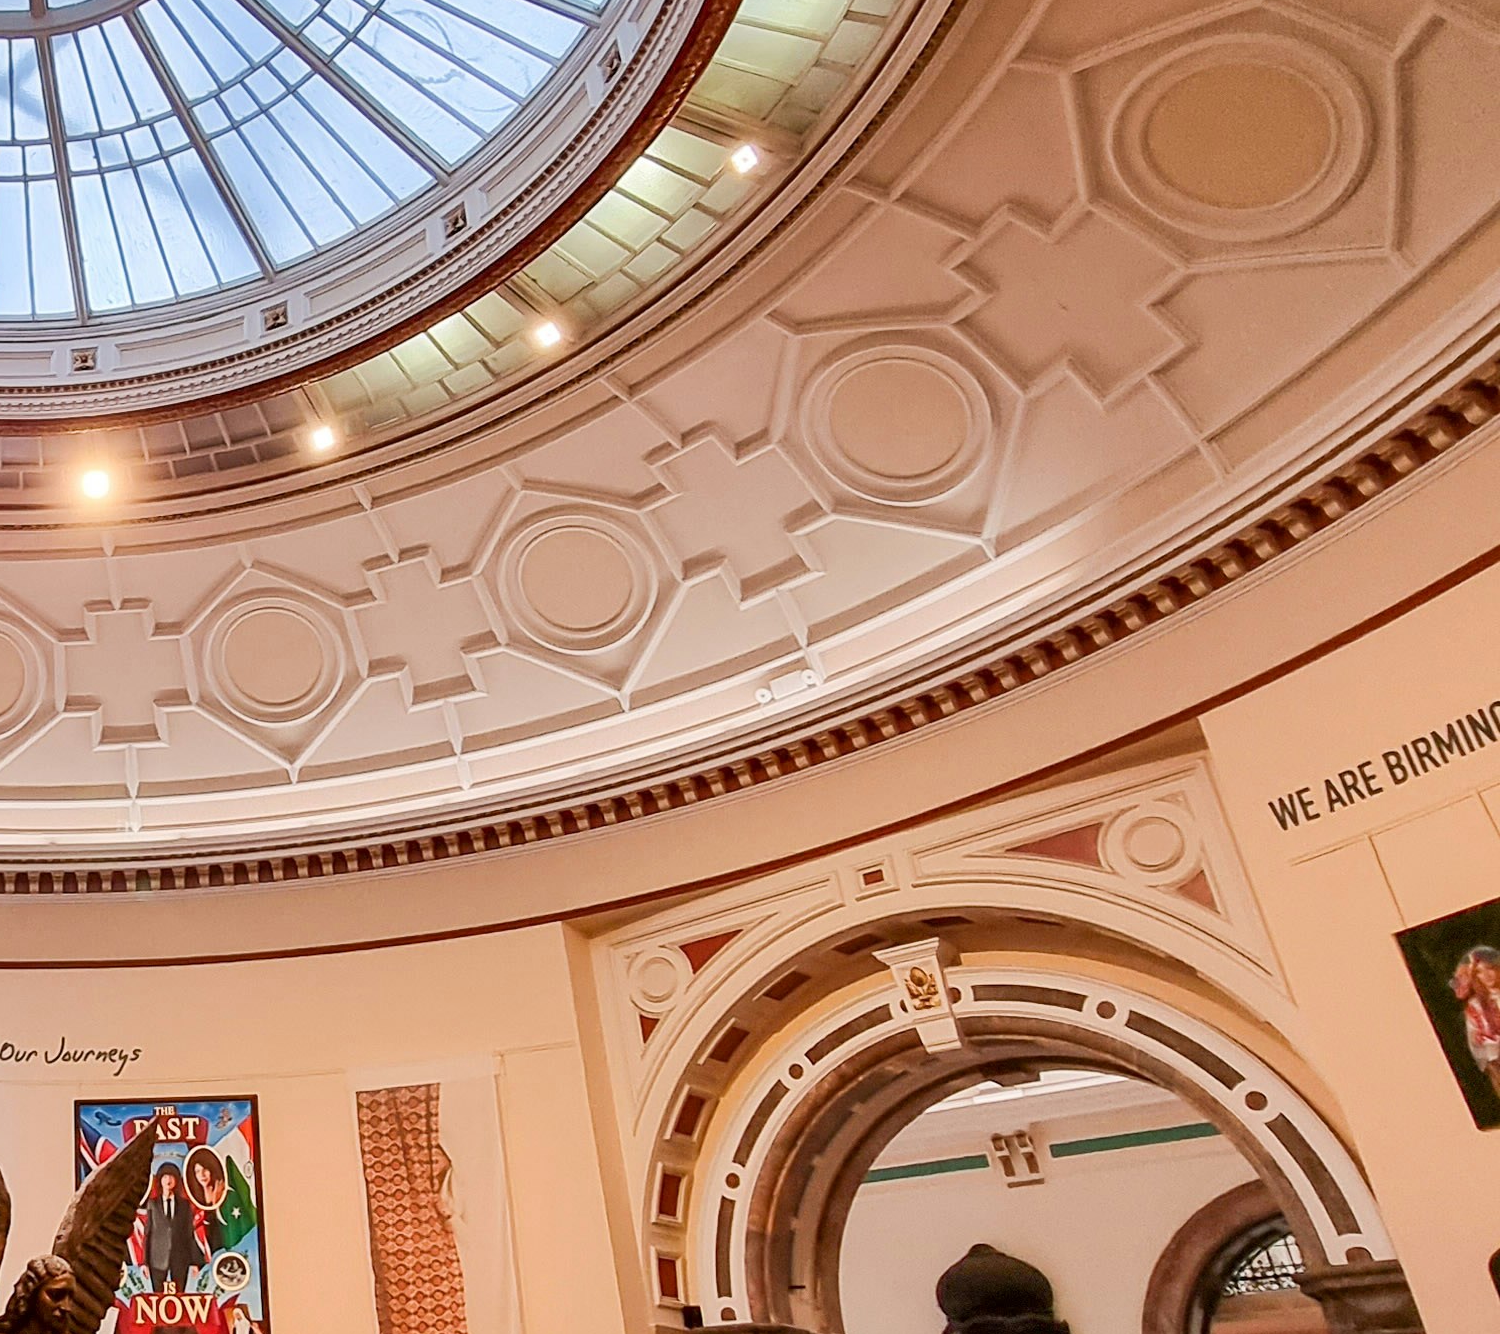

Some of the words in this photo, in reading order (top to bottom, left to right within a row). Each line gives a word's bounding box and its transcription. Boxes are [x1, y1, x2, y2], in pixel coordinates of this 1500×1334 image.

[1268, 787, 1321, 831] WE
[1324, 760, 1384, 813] ARE
[0, 1041, 38, 1063] Our
[44, 1036, 143, 1077] Journeys
[153, 1105, 176, 1116] THE
[133, 1117, 200, 1140] PAST
[162, 1281, 177, 1296] IS
[135, 1294, 213, 1325] NOW
